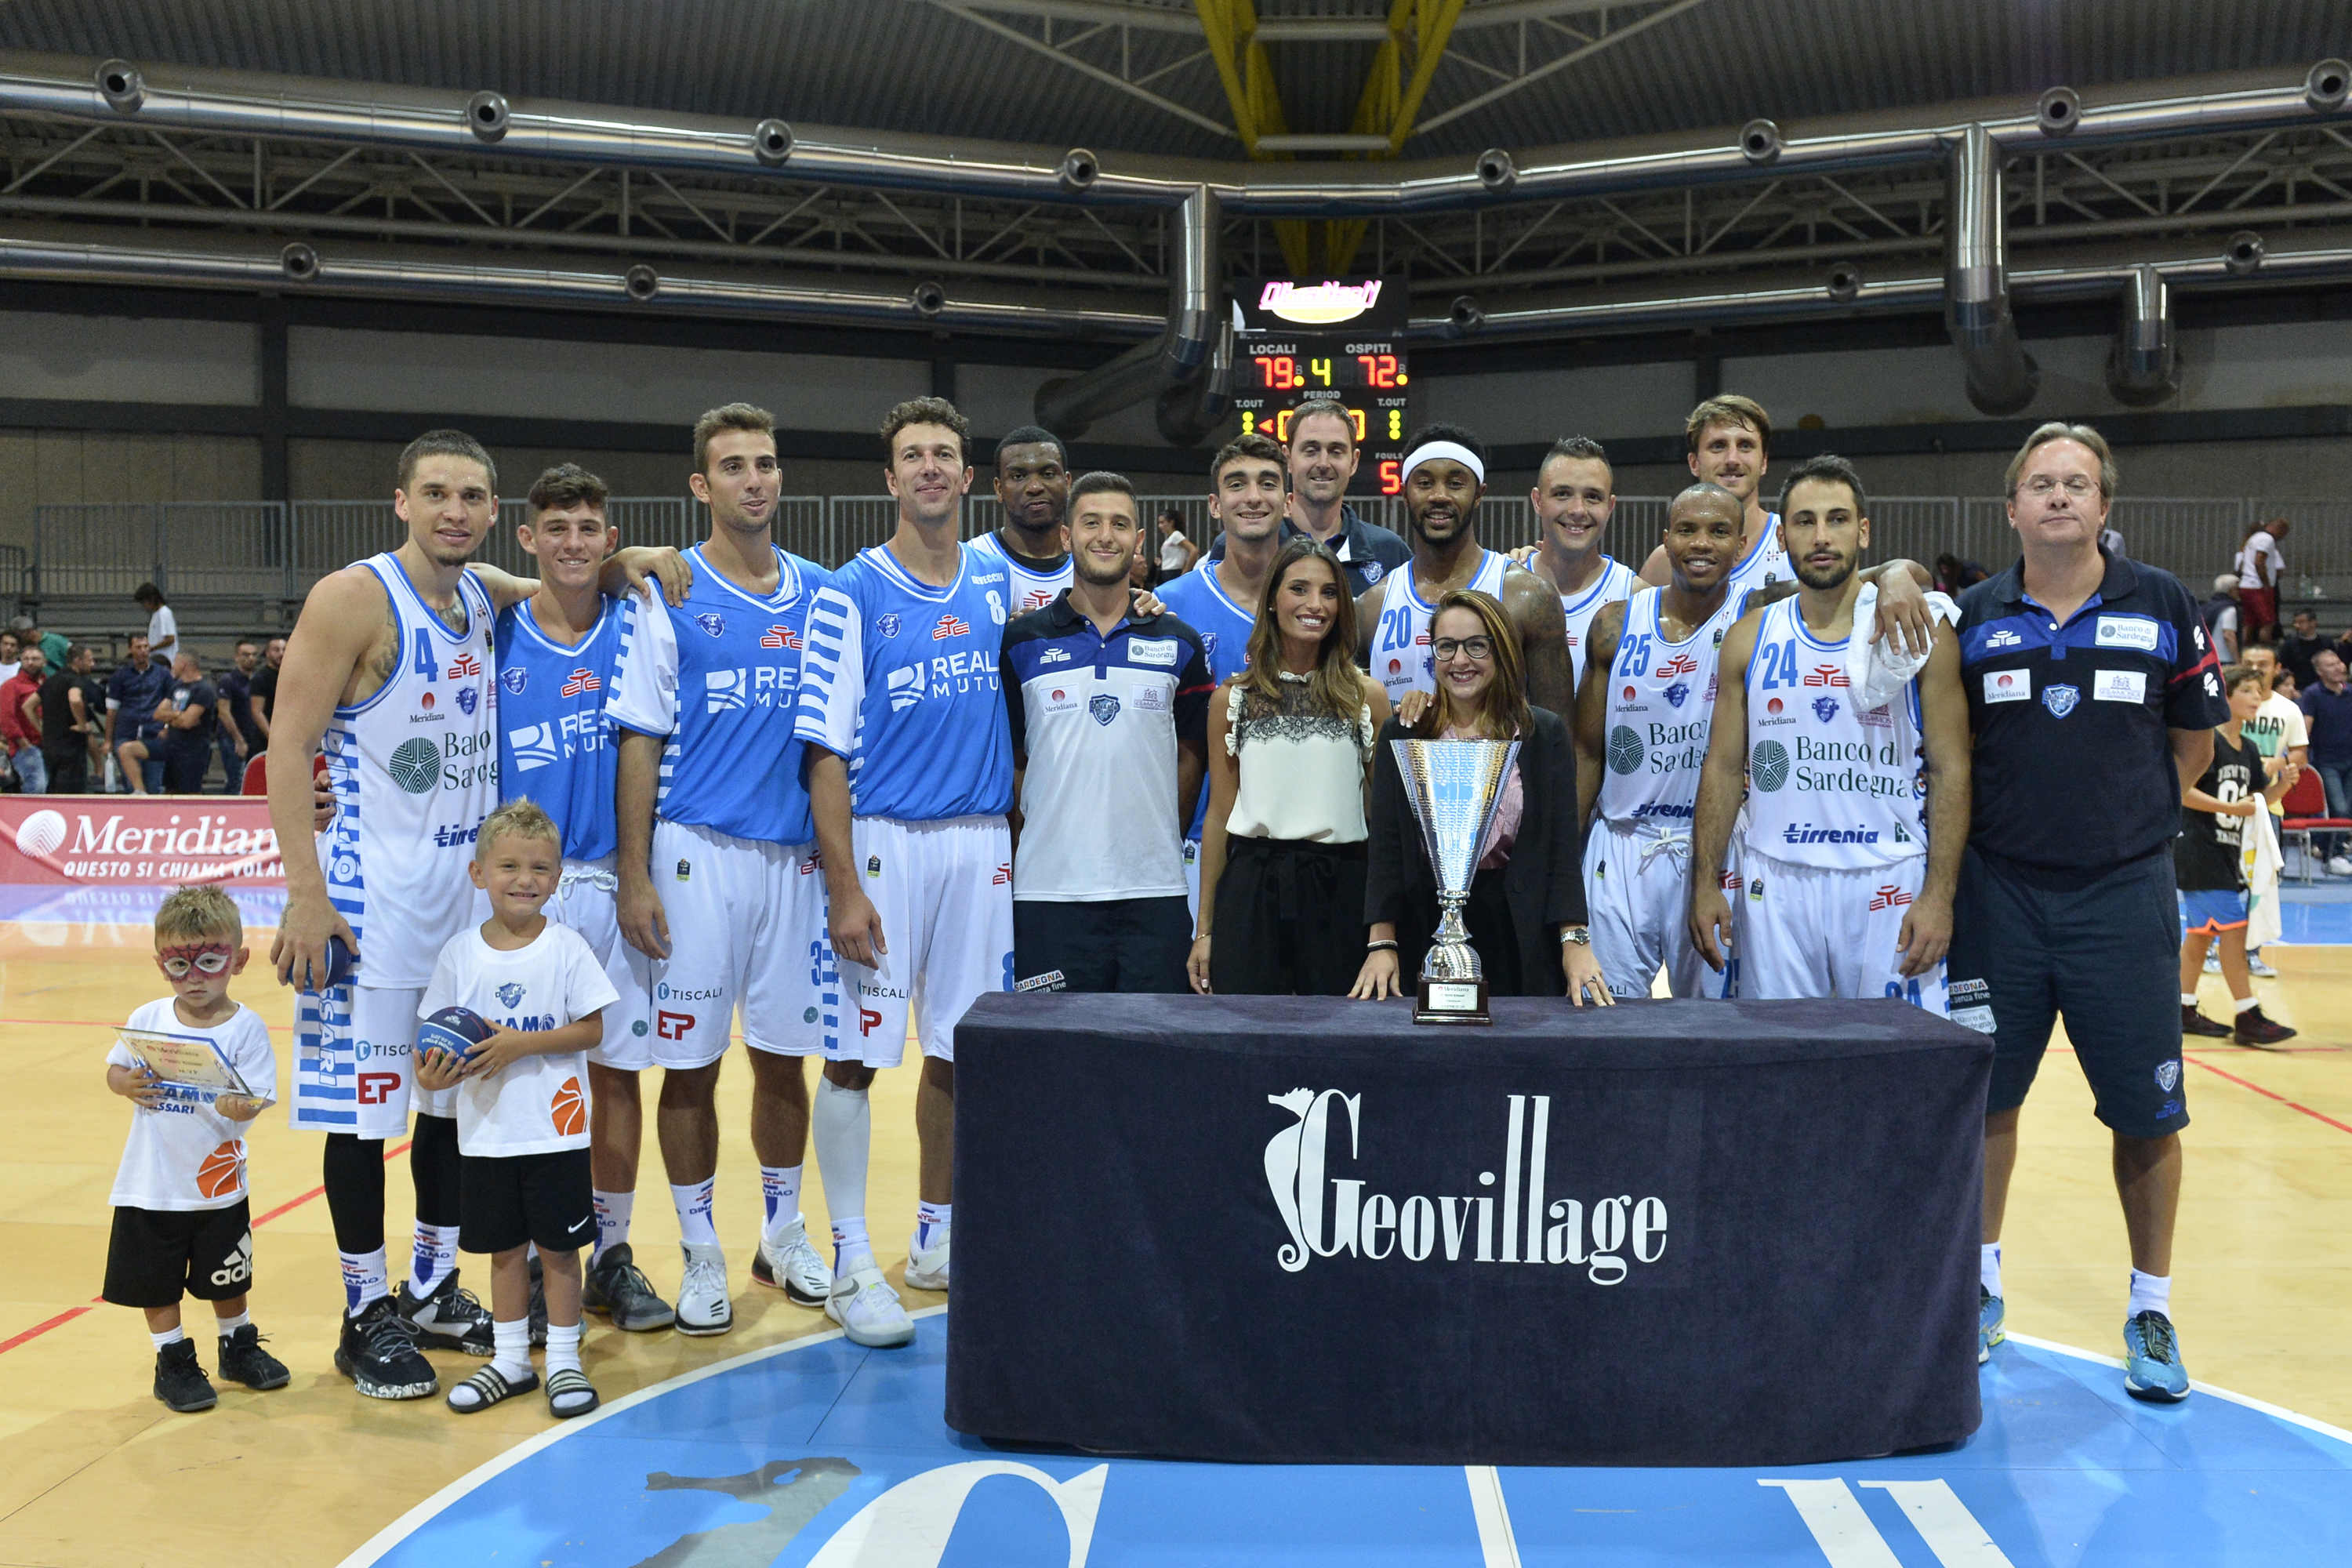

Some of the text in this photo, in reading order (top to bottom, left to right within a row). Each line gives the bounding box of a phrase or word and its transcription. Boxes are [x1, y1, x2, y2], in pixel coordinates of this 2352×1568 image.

[1249, 343, 1391, 354] LOCALI OSPITI
[1254, 355, 1397, 389] 79 4 72
[1236, 399, 1264, 408] T.OUT
[1303, 390, 1341, 399] PERIOD
[1380, 461, 1399, 494] 5
[985, 590, 1007, 625] 8
[1382, 605, 1410, 652] 20
[415, 628, 438, 682] 4
[932, 650, 1000, 681] REAL
[1620, 633, 1652, 677] 25
[1762, 638, 1798, 691] 24
[755, 666, 801, 691] RE
[932, 675, 1000, 699] MUTU
[1987, 688, 2026, 699] Meridiana
[409, 713, 445, 724] Meridiana
[1044, 702, 1079, 713] Meridiana
[1615, 704, 1649, 713] Meridiana
[1757, 717, 1797, 728] Meridiana
[1795, 735, 1871, 763] Banco
[1795, 766, 1908, 800] Sardegna
[1783, 822, 1879, 844] tirrenia
[64, 862, 131, 878] QUESTO
[136, 862, 153, 878] SI
[158, 862, 225, 878] CHIAMA
[671, 987, 723, 1000] TISCALI
[862, 984, 909, 999] TISCALI
[1014, 971, 1063, 991] SARDEGNA
[657, 1008, 695, 1040] EP
[859, 1005, 882, 1037] P
[358, 1072, 401, 1105] EP
[1298, 1088, 1668, 1286] Geovillage
